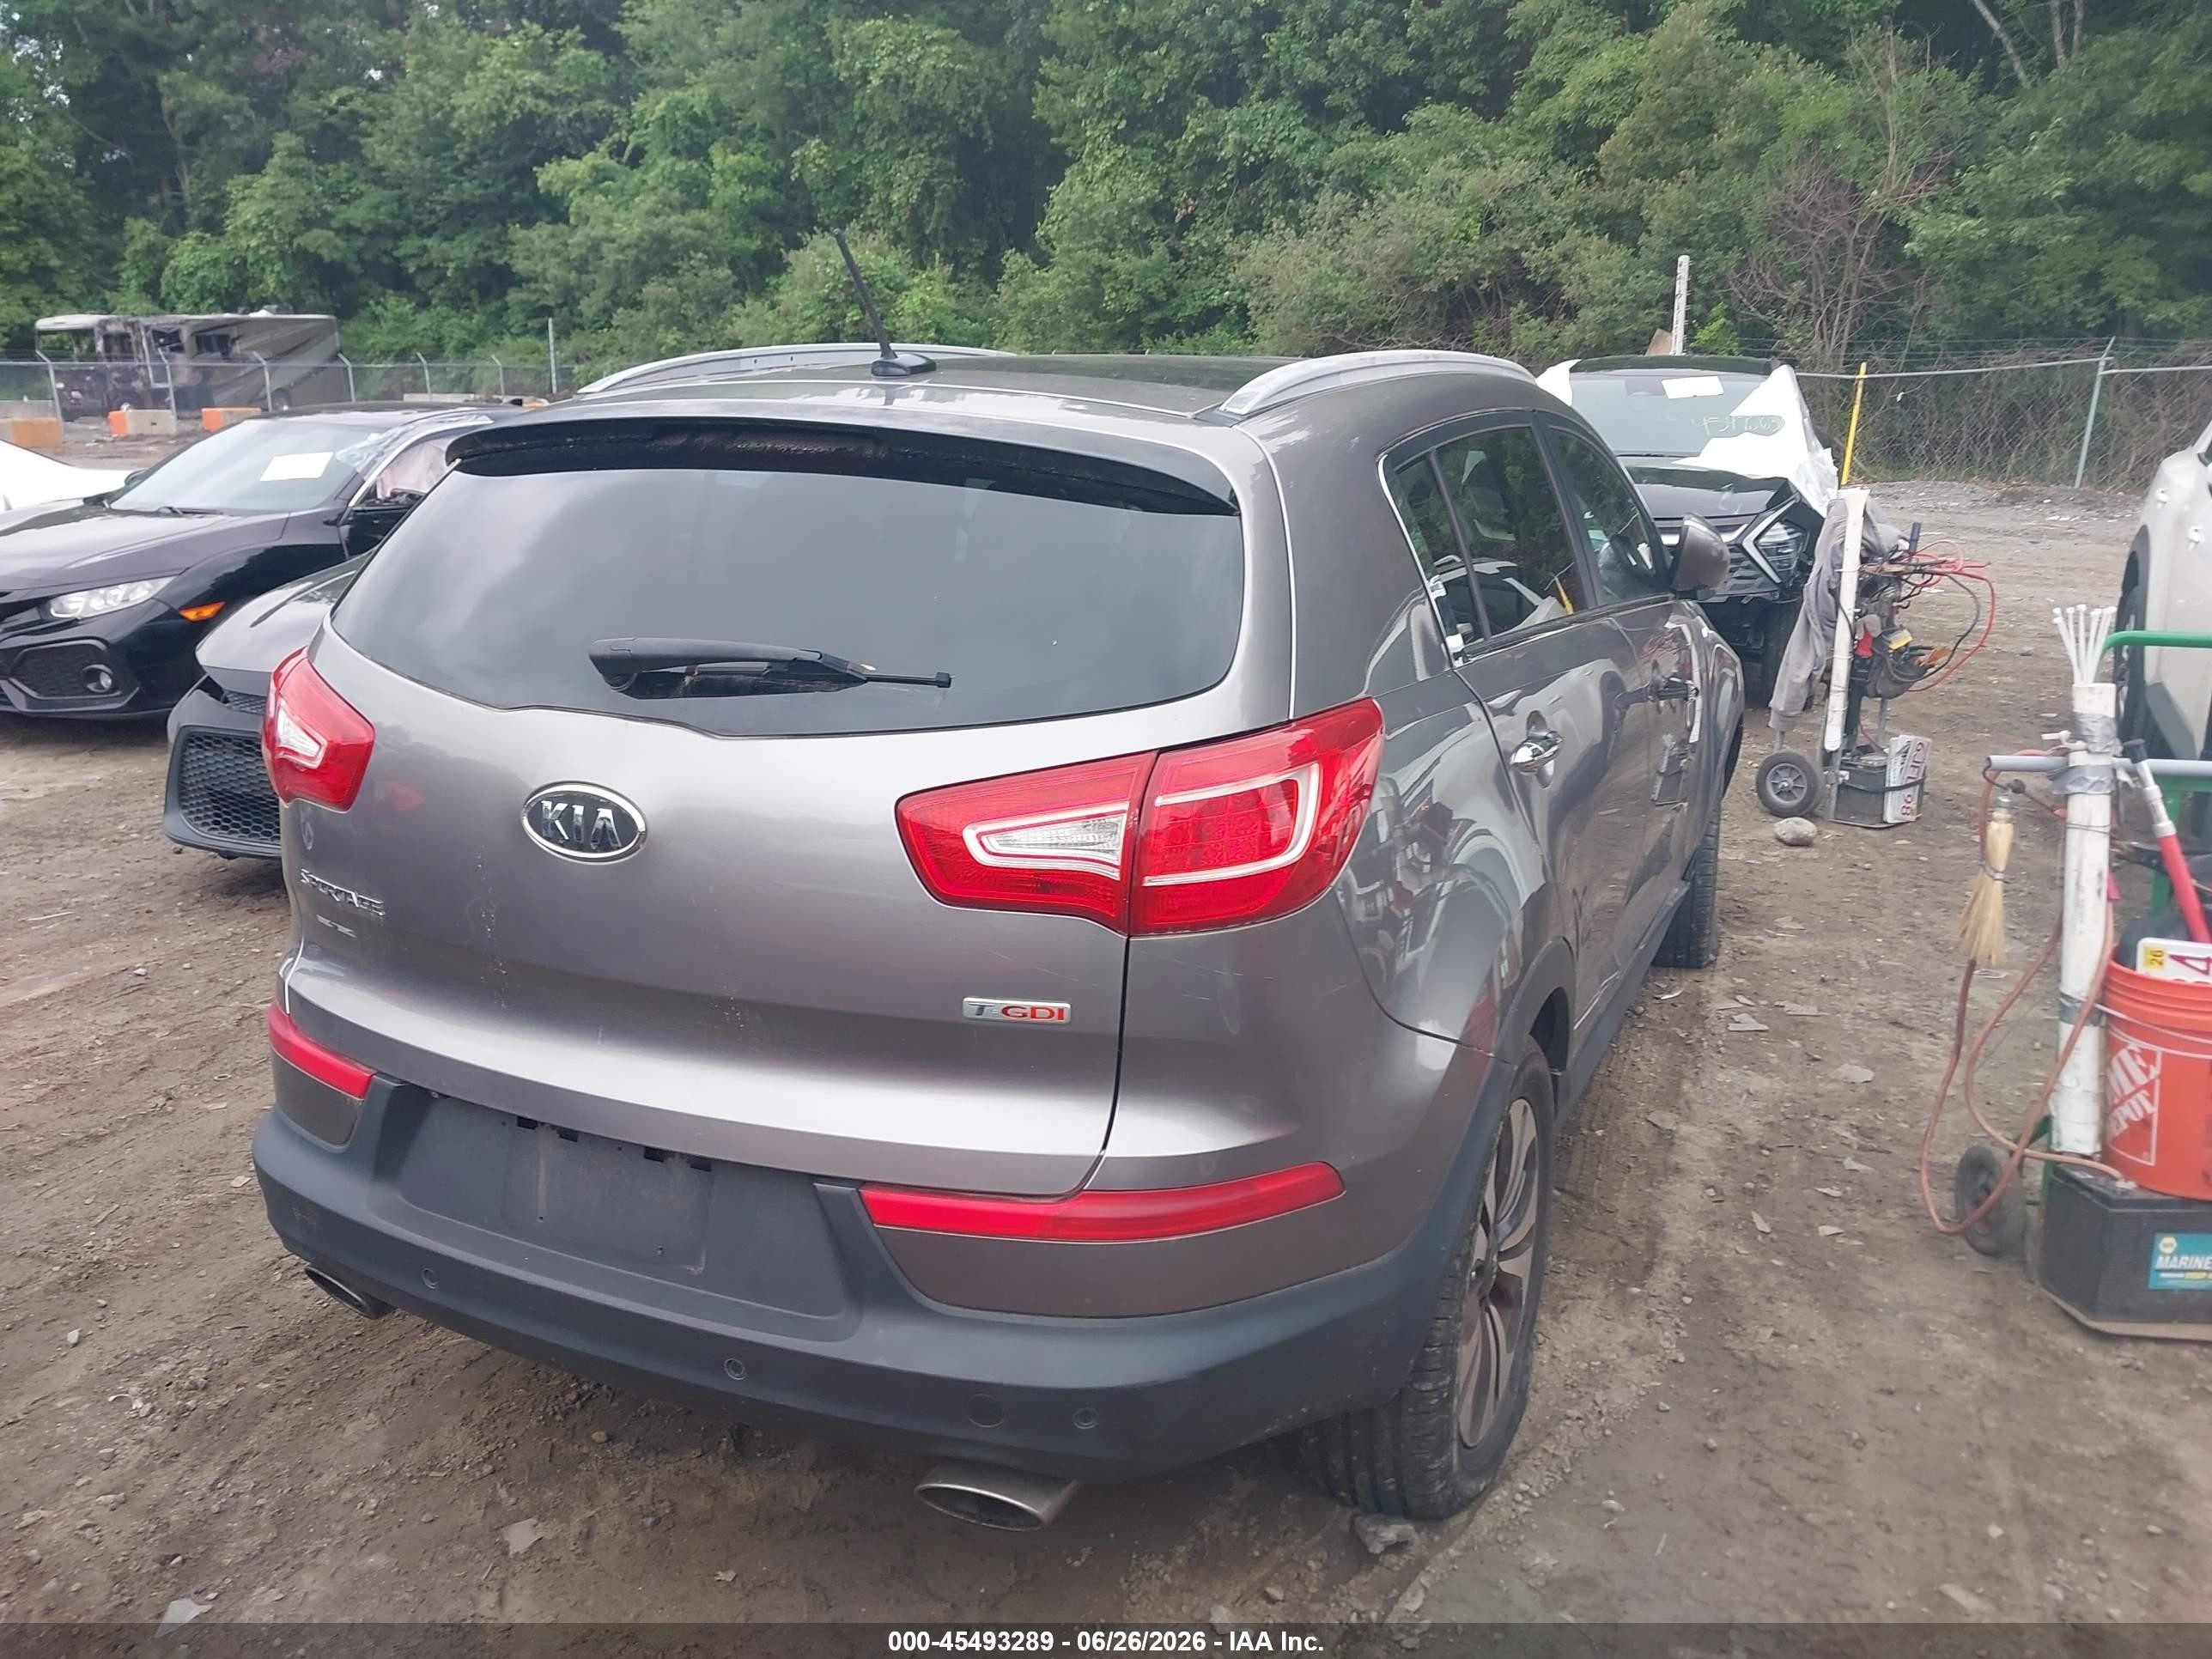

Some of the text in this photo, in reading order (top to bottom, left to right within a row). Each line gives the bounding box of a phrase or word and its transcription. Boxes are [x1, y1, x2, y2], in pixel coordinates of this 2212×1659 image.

[540, 799, 623, 851] KIA
[968, 1002, 1065, 1021] T-GDI
[2155, 1254, 2212, 1270] MARINE
